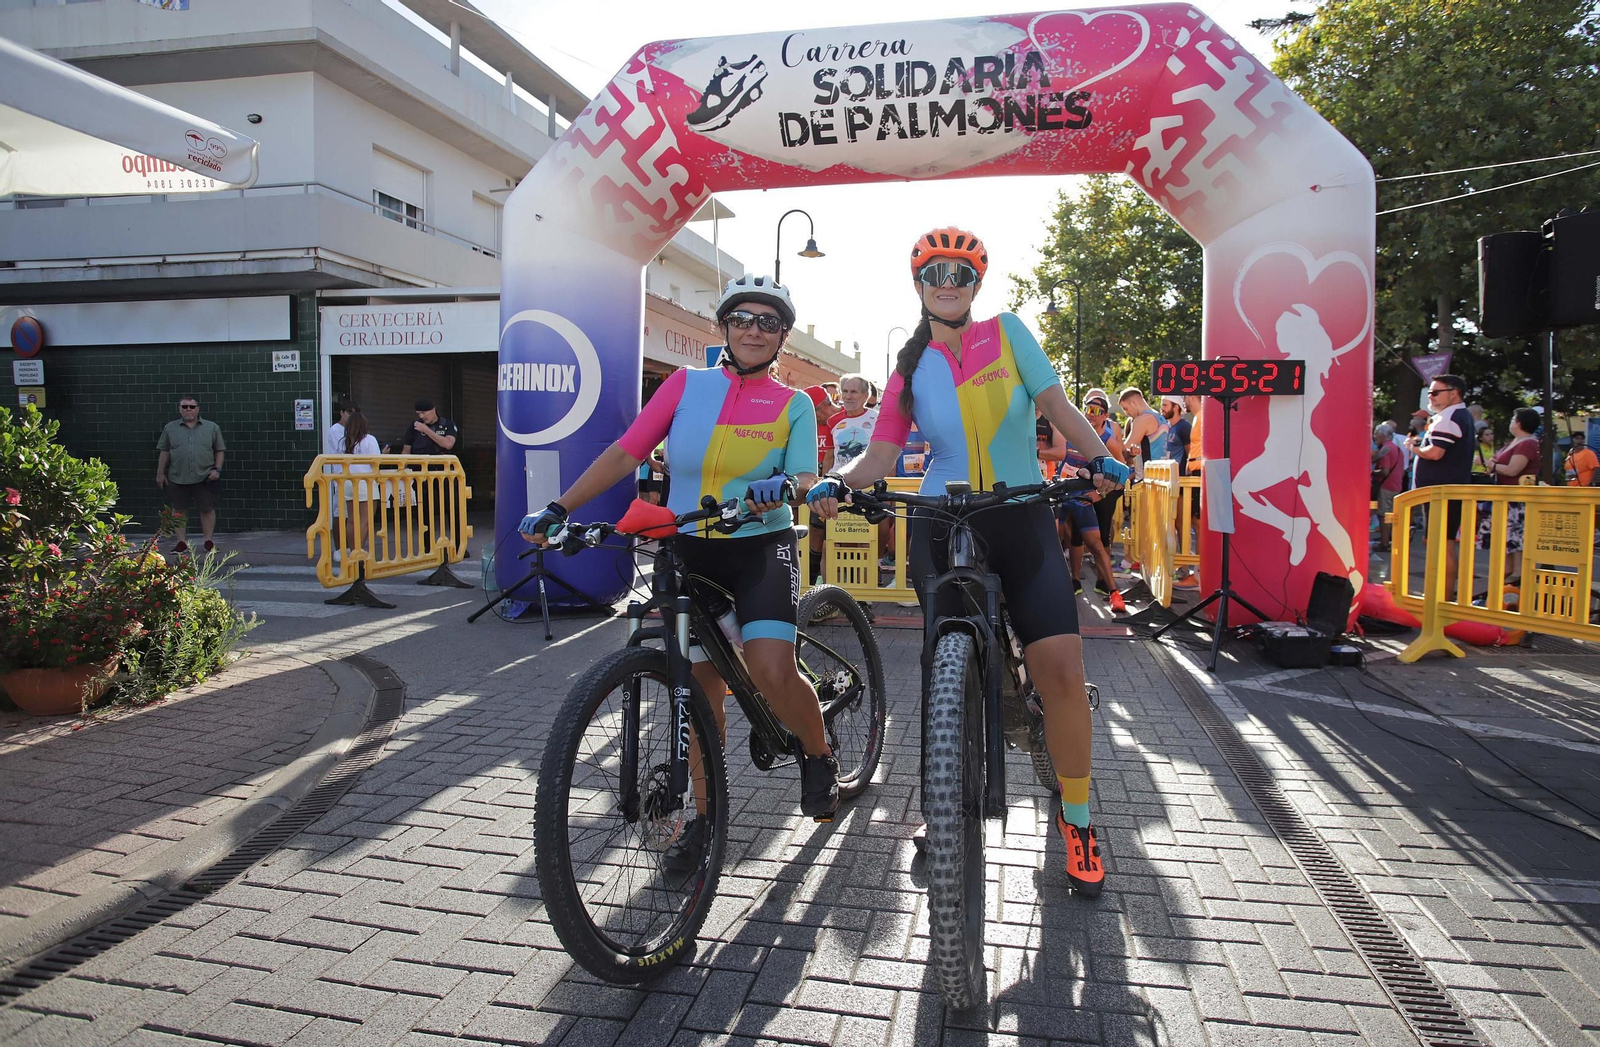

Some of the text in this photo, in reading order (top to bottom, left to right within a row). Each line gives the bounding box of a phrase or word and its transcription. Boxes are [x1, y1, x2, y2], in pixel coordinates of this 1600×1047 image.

[781, 32, 913, 68] Carrera
[813, 51, 1051, 105] SOLIDARIA
[778, 91, 1093, 147] DE PALMONES
[187, 153, 222, 172] reciclado
[338, 308, 444, 328] CERVECERÍA
[338, 330, 444, 347] GIRALDILLO
[1537, 538, 1580, 546] Ayuntamiento
[1552, 545, 1580, 553] Barrios
[637, 935, 684, 967] MAXXIS
